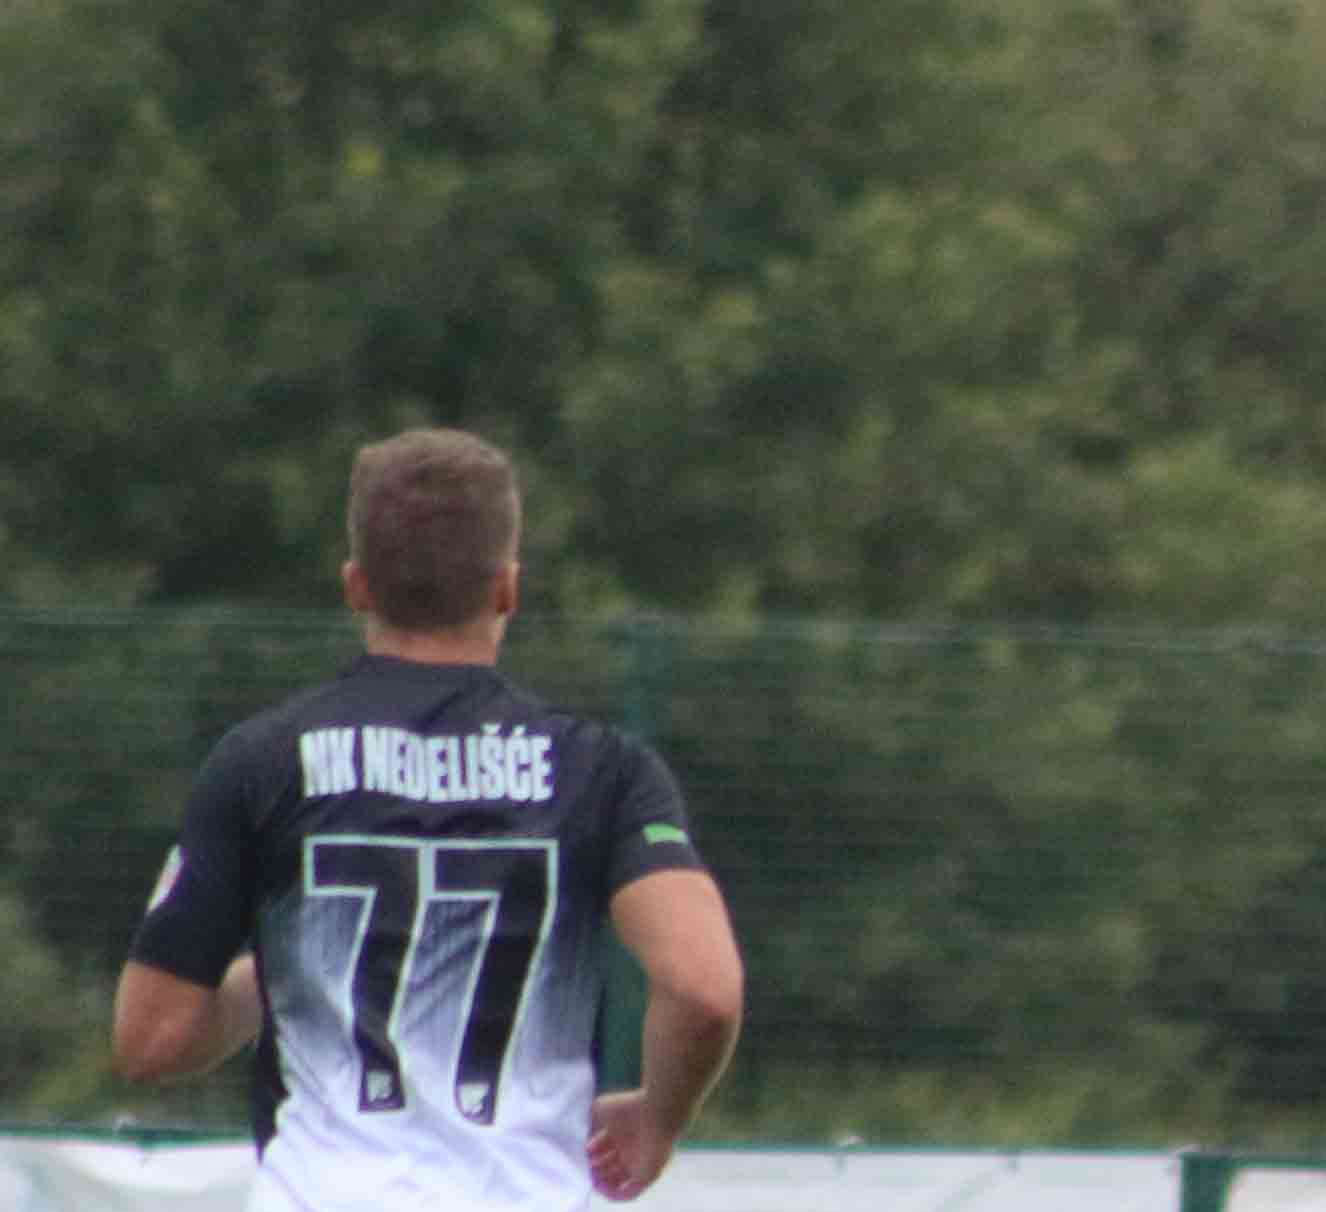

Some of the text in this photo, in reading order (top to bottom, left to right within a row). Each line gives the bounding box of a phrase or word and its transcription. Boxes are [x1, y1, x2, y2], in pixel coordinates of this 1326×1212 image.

[300, 723, 553, 803] NK NEDELIŠĆE
[303, 834, 558, 1126] 77
